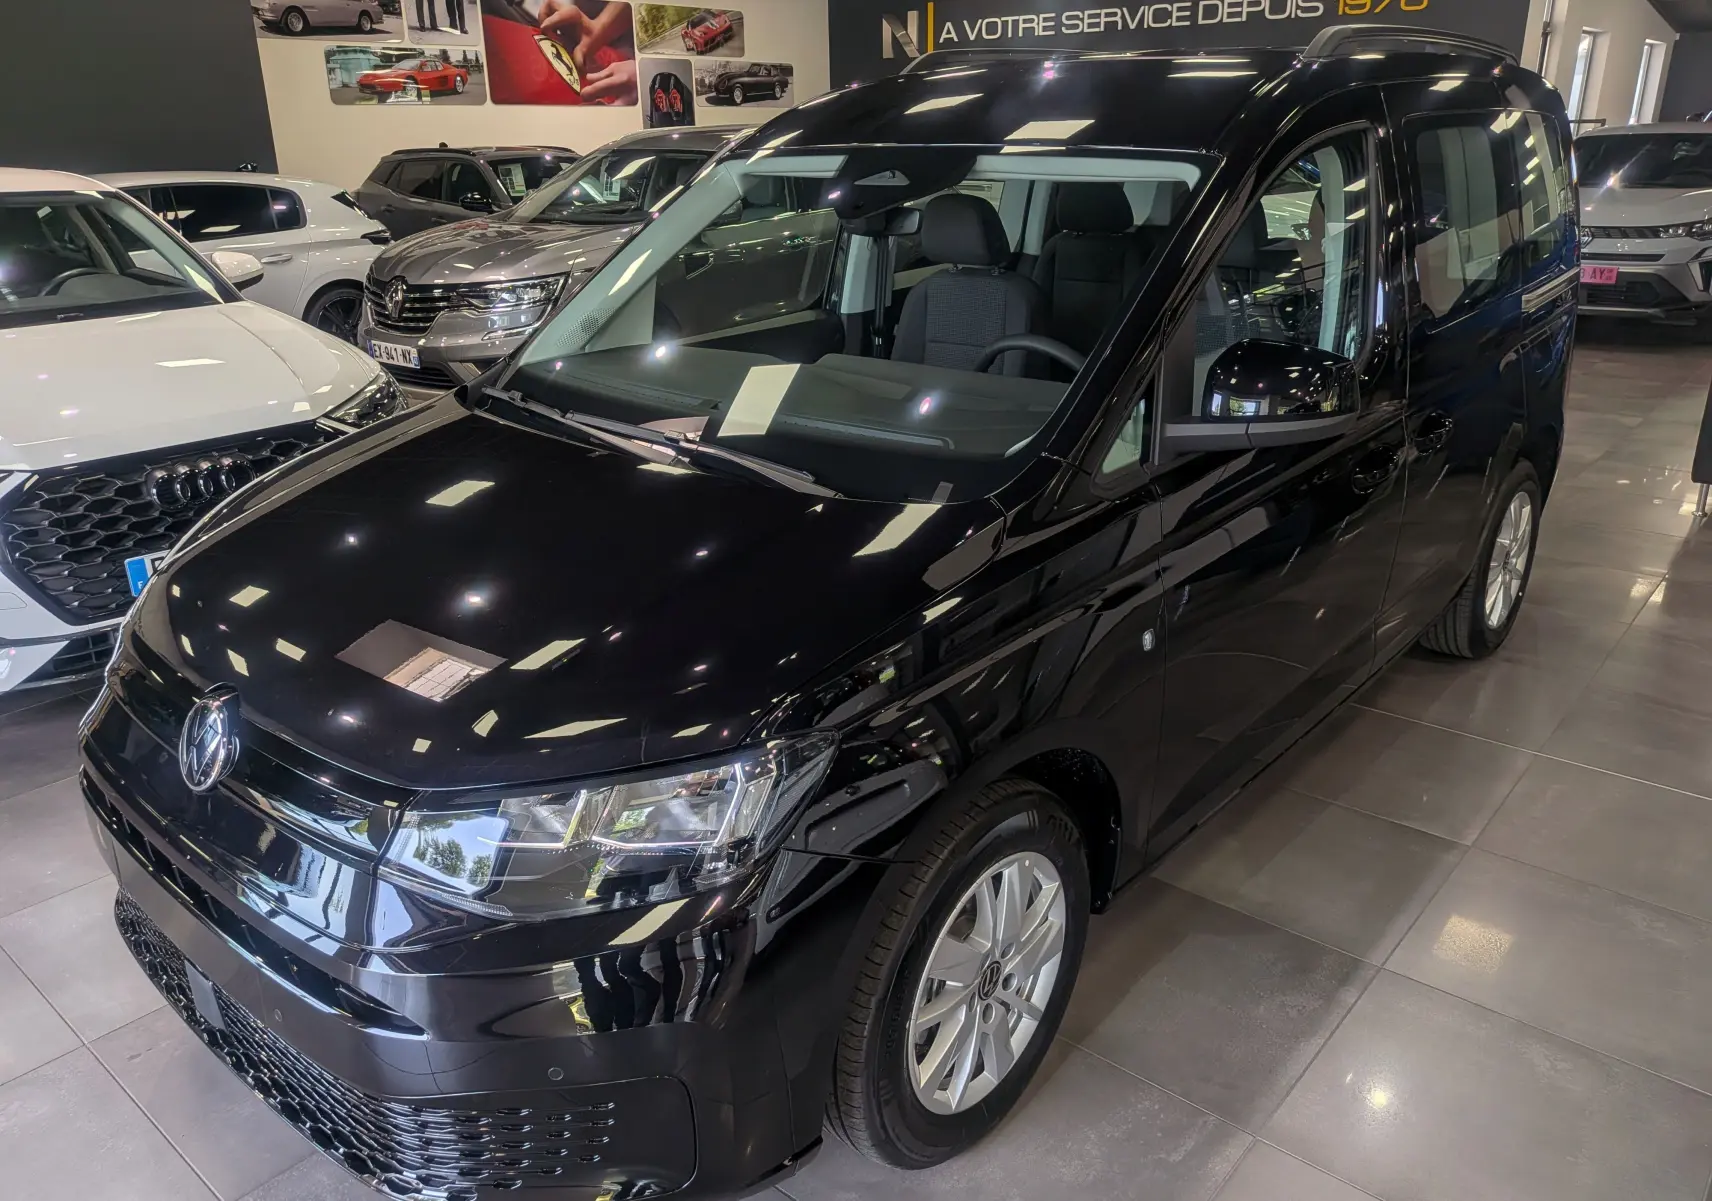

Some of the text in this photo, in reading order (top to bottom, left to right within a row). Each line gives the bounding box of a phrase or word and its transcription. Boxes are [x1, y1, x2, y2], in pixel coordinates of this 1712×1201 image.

[939, 21, 959, 43] A
[963, 13, 1056, 41] VOTRE
[1061, 2, 1193, 34] SERVICE
[1198, 0, 1324, 24] DEPUIS
[373, 343, 413, 365] EX-941-NX
